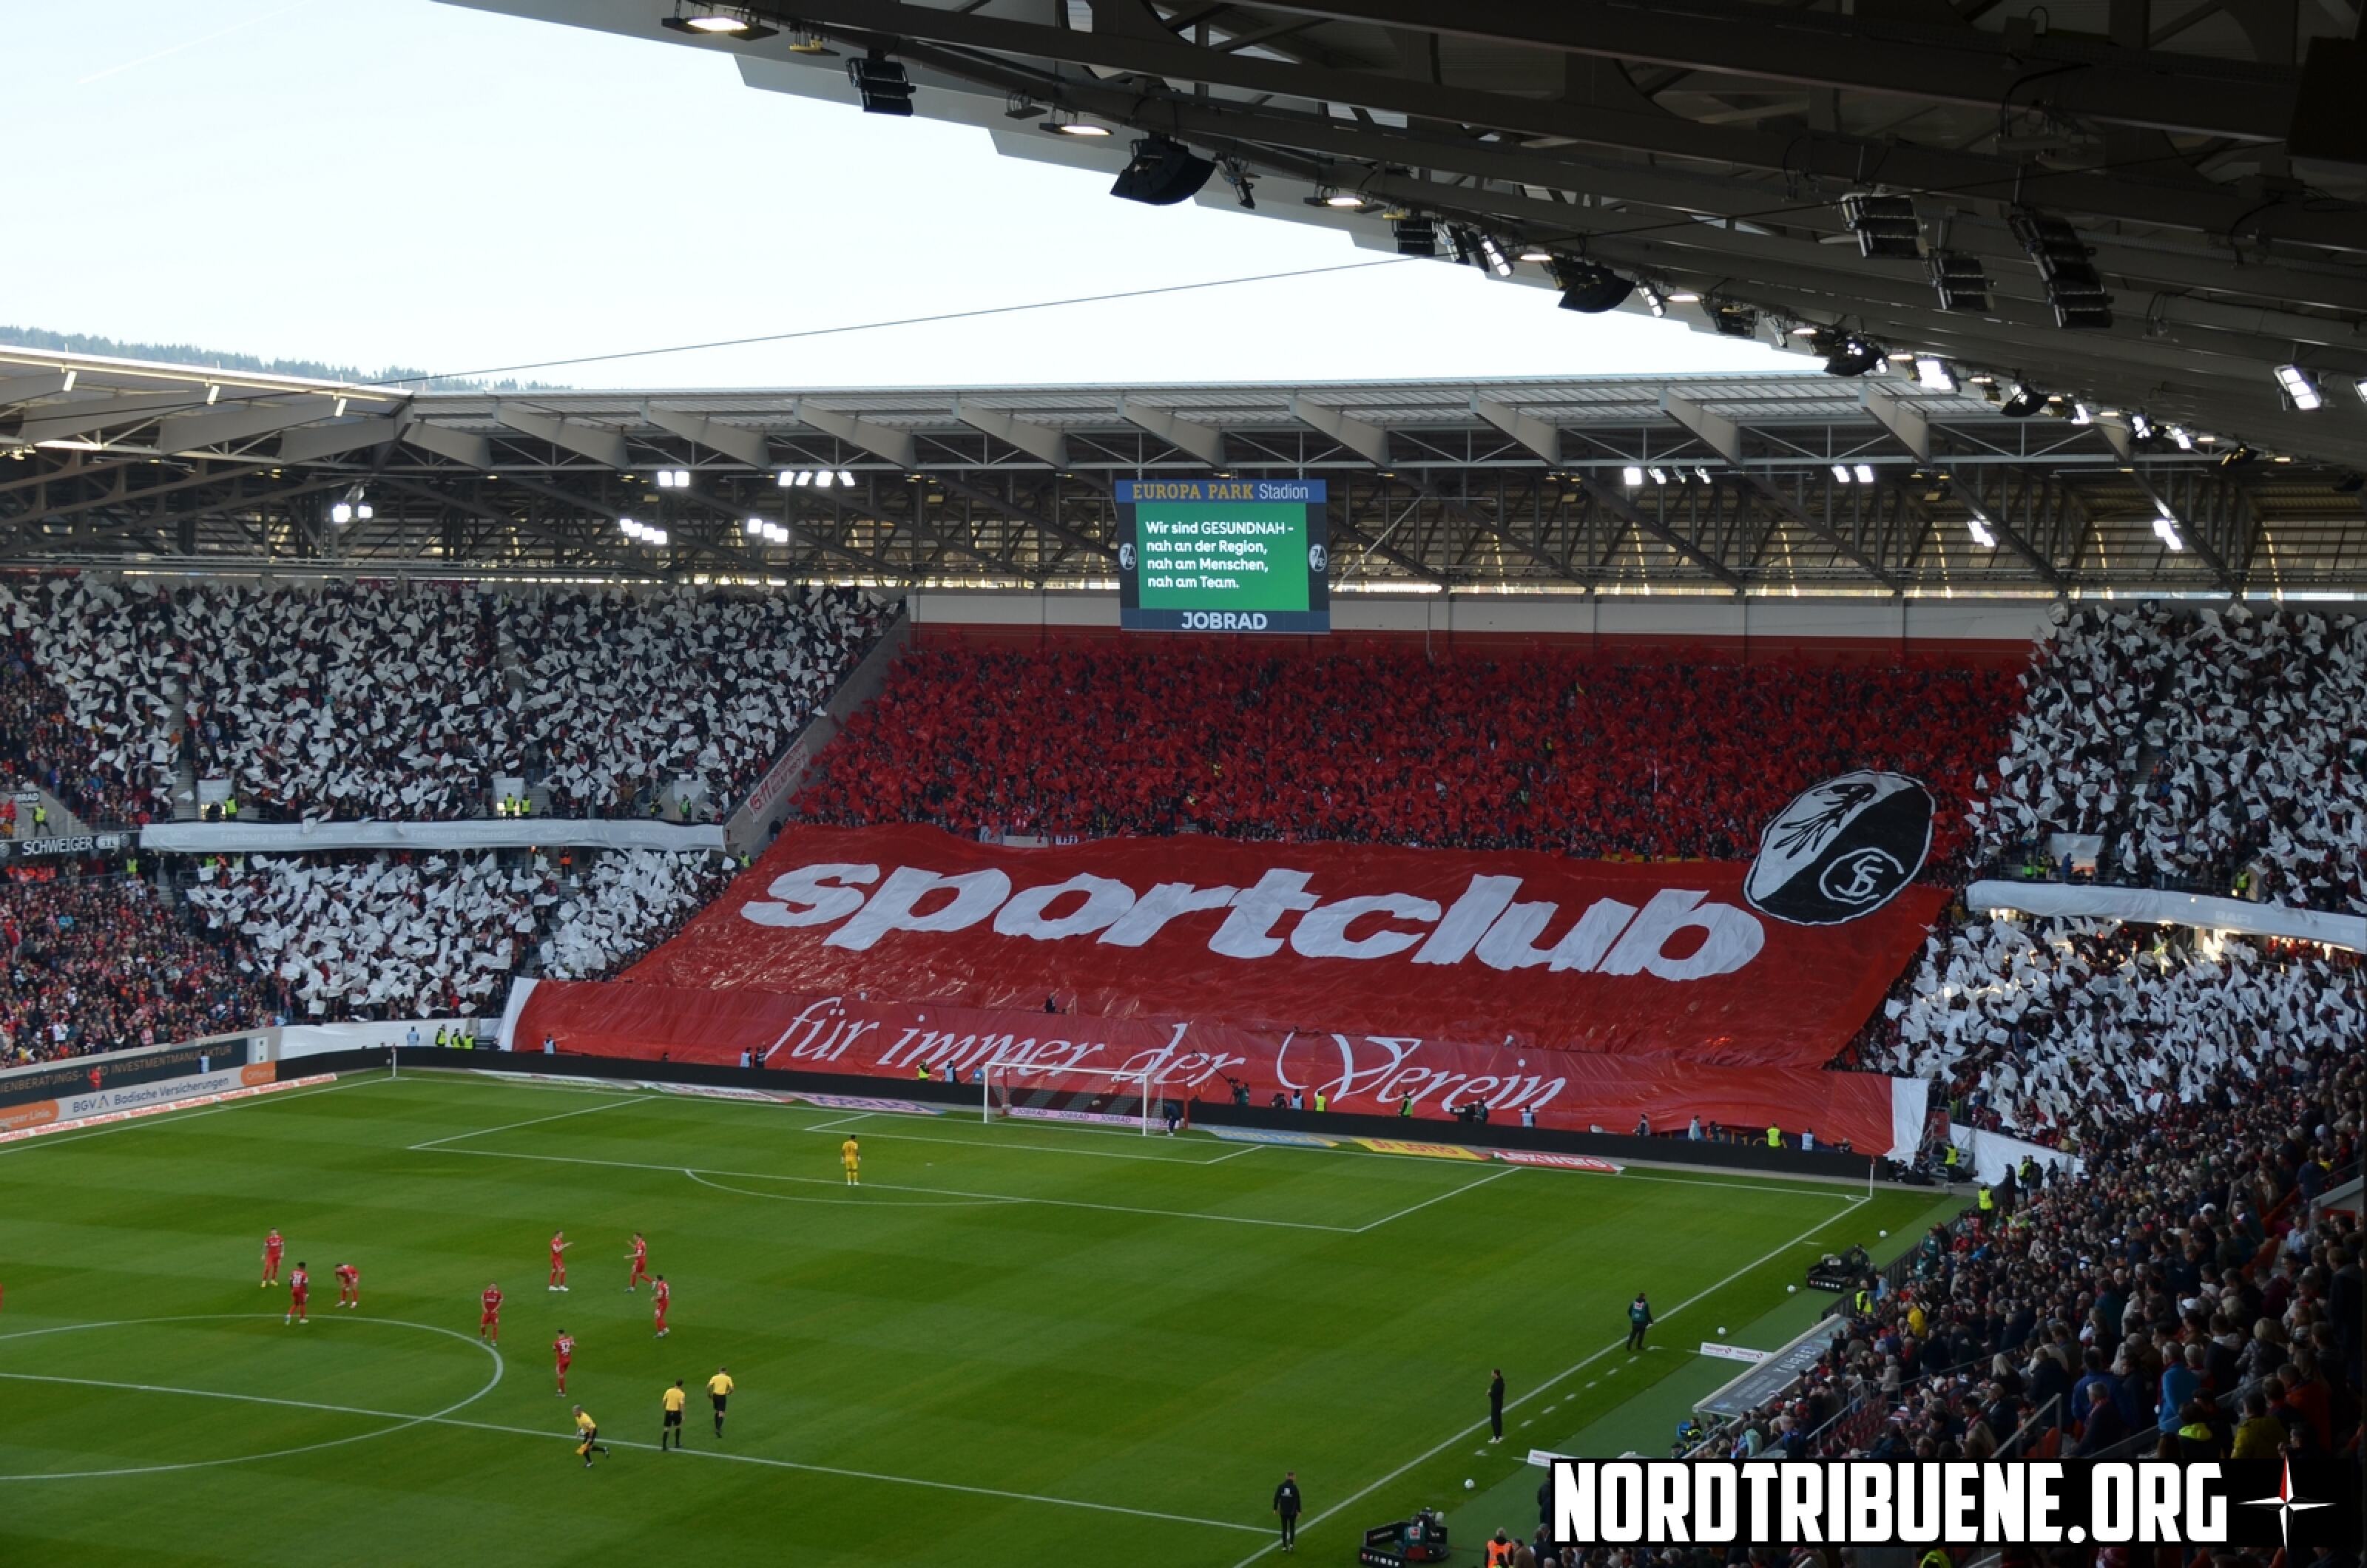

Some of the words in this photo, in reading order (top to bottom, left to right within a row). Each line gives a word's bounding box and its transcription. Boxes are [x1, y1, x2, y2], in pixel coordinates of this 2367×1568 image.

[1132, 484, 1202, 499] EUROPA
[1208, 484, 1255, 499] PARK
[1259, 483, 1309, 499] Stadion
[1146, 521, 1169, 535] Wir
[1171, 521, 1198, 535] sind
[1201, 521, 1286, 535] GESUNDNAH
[1146, 540, 1170, 552] nah
[1175, 543, 1192, 552] an
[1195, 540, 1216, 552] der
[1219, 540, 1268, 555] Region,
[1147, 558, 1172, 570] nah
[1175, 561, 1196, 570] am
[1199, 558, 1269, 573] Menschen,
[1147, 575, 1173, 588] nah
[1175, 578, 1198, 588] am
[1199, 575, 1240, 589] Team.
[1181, 612, 1267, 629] JOBRAD
[22, 837, 94, 856] SCHWEIGER
[740, 864, 1765, 981] sportclub
[763, 996, 879, 1062] für
[877, 1014, 1104, 1078] immer
[1110, 1022, 1246, 1087] der
[1275, 1031, 1566, 1112] Verein
[72, 1099, 97, 1113] BGV
[114, 1089, 158, 1106] Badische
[158, 1077, 229, 1098] Versicherungen
